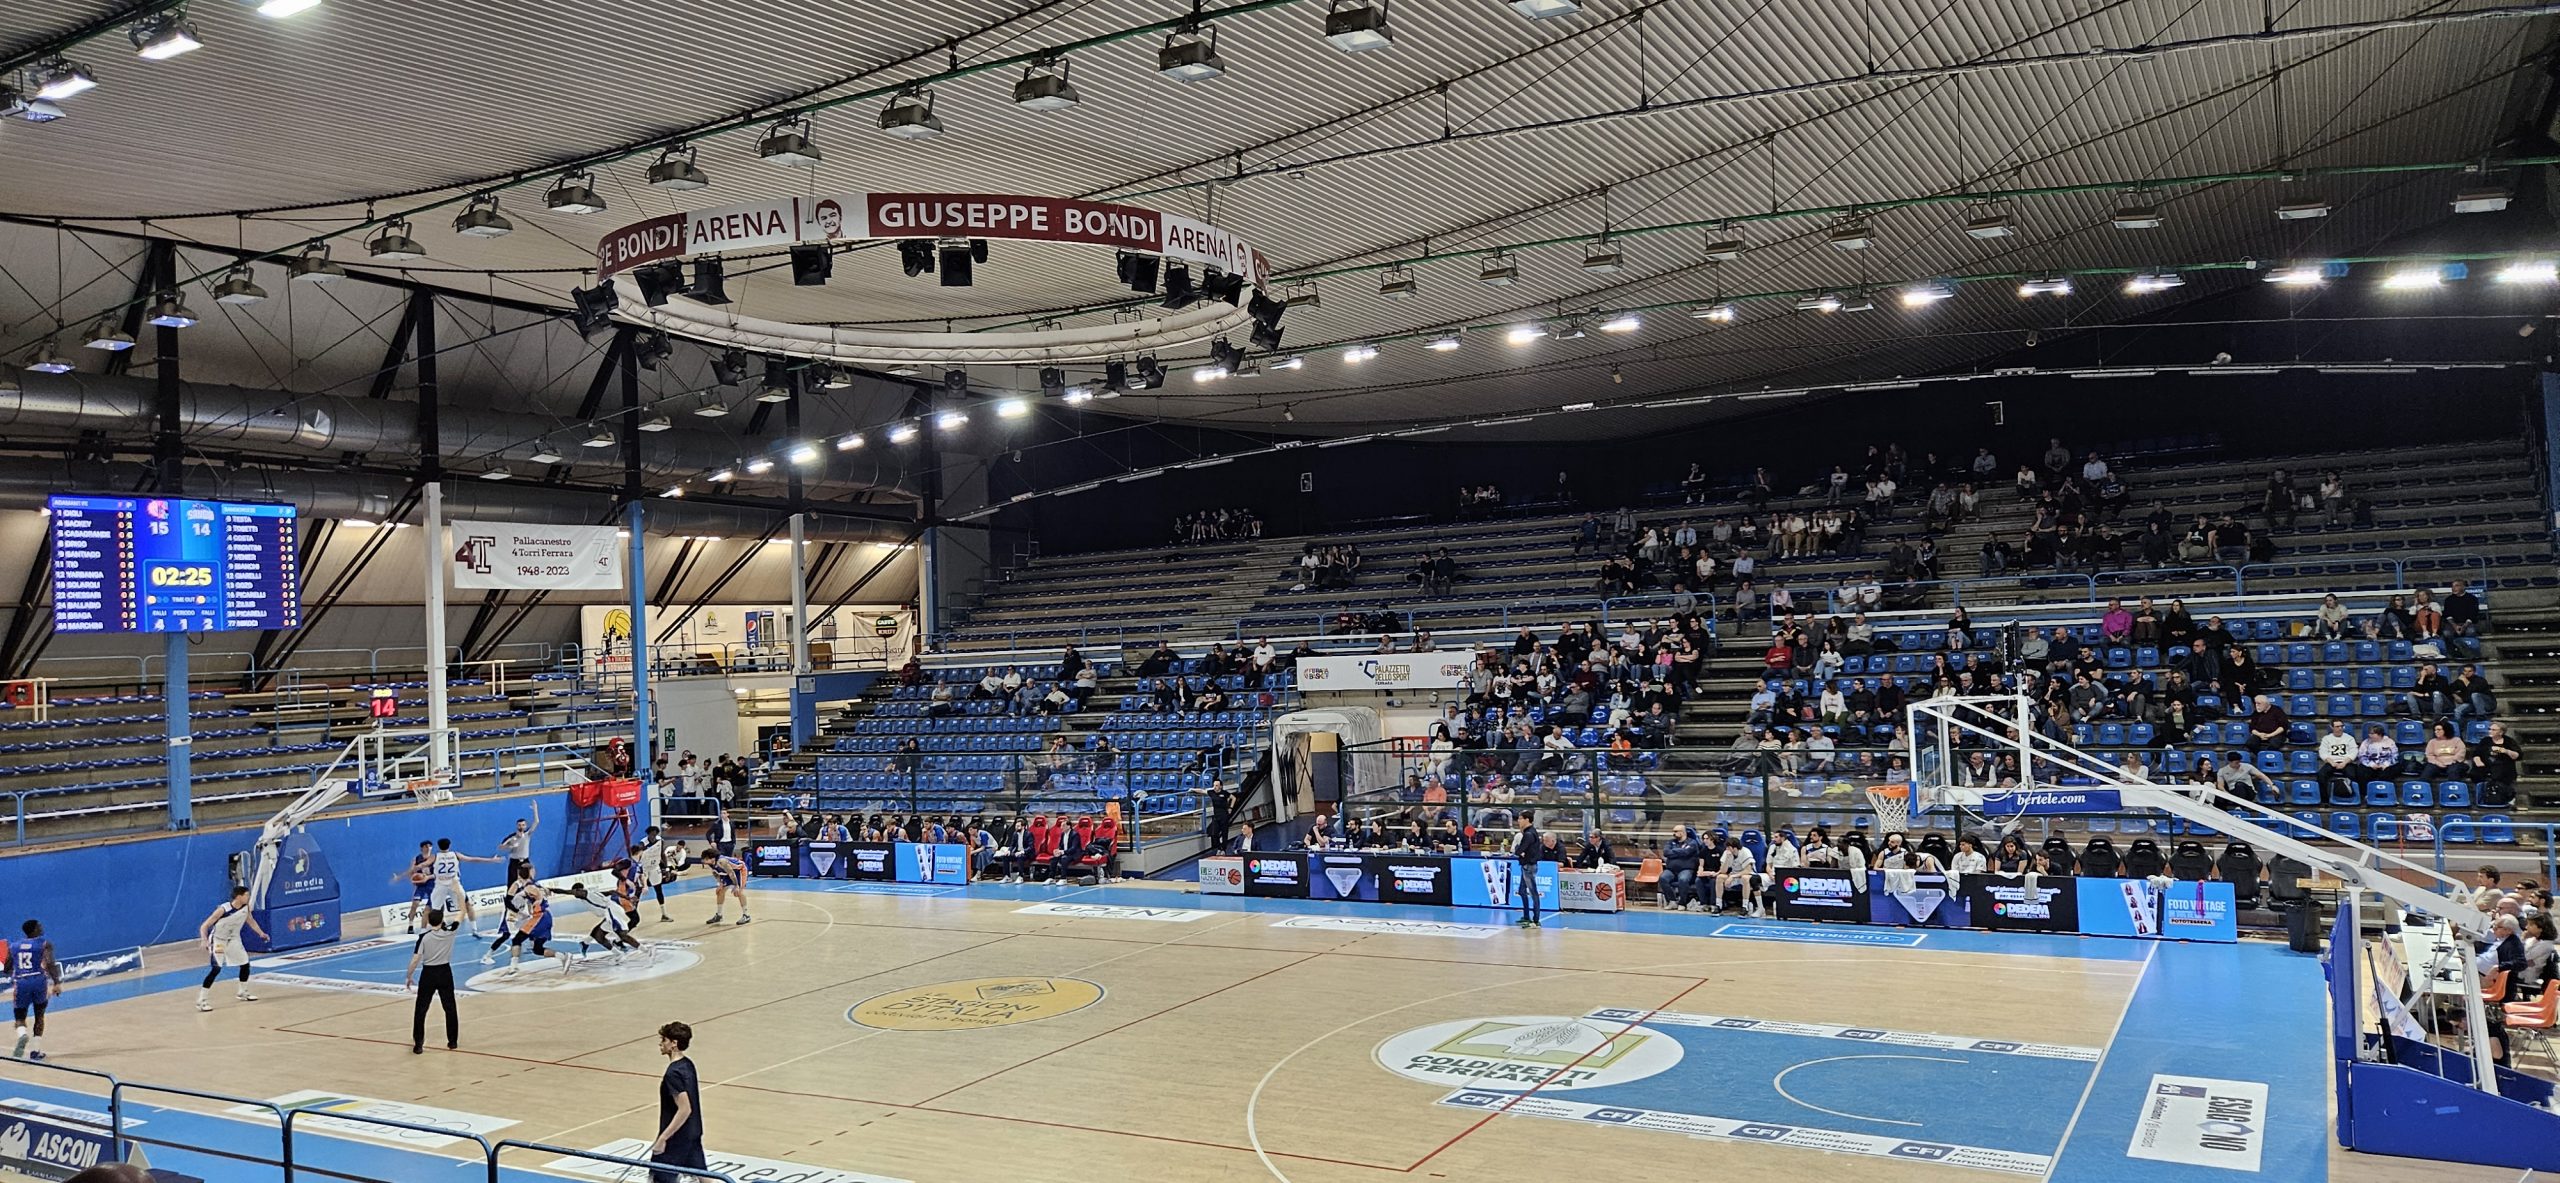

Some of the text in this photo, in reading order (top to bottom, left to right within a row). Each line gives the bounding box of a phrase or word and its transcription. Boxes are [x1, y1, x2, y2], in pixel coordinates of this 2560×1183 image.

[692, 210, 787, 244] ARENA
[878, 202, 1156, 242] GIUSEPPE BONDI
[618, 224, 679, 263] BONDI
[1168, 225, 1228, 262] ARENA
[149, 521, 169, 536] 15
[192, 522, 211, 536] 14
[513, 536, 572, 546] Pallacanestro
[456, 536, 496, 574] 4T
[512, 549, 574, 558] 4 Torri Ferrara
[152, 566, 212, 586] 02:25
[517, 566, 570, 576] 1948 2023
[154, 618, 214, 631] 4 1 2
[1375, 664, 1410, 673] PALAZZETTO
[372, 698, 395, 717] 14
[2331, 744, 2346, 756] 23
[2017, 793, 2086, 806] bertele.com
[438, 862, 456, 874] 22
[1261, 860, 1297, 872] DEDEM
[1403, 880, 1433, 888] DEDEM
[1560, 881, 1593, 890] LEGA
[1799, 878, 1852, 891] DEDEM
[2006, 903, 2049, 914] DEDEM
[2168, 899, 2189, 910] FOTO
[1323, 919, 1500, 932] ADAMANT
[18, 952, 32, 969] 13
[905, 996, 1040, 1012] STAGIONI
[882, 1002, 1014, 1019] D'ITALIA
[1600, 1010, 1631, 1018] CFI
[1719, 1019, 1753, 1027] CFI
[1844, 1030, 1879, 1038] CFI
[1978, 1041, 2015, 1050] CFI
[1410, 1055, 1597, 1080] COLDIRETTI
[1404, 1064, 1573, 1087] FERRARA
[1459, 1094, 1494, 1105] CFI
[1596, 1110, 1634, 1120] CFI
[1648, 1112, 1690, 1120] Centro
[1631, 1121, 1712, 1133] Innovazione
[1640, 1116, 1716, 1128] Formazione
[2196, 1096, 2256, 1152] ESAGONO
[1742, 1127, 1781, 1137] CFI
[1797, 1129, 1842, 1138] Centro
[1781, 1138, 1870, 1151] Innovazione
[1789, 1133, 1872, 1146] Formazione
[34, 1132, 102, 1168] ASCOM
[1902, 1146, 1943, 1156] CFI
[1960, 1148, 2010, 1157] Centro
[1946, 1158, 2044, 1173] Innovazione
[1953, 1152, 2045, 1167] Formazione
